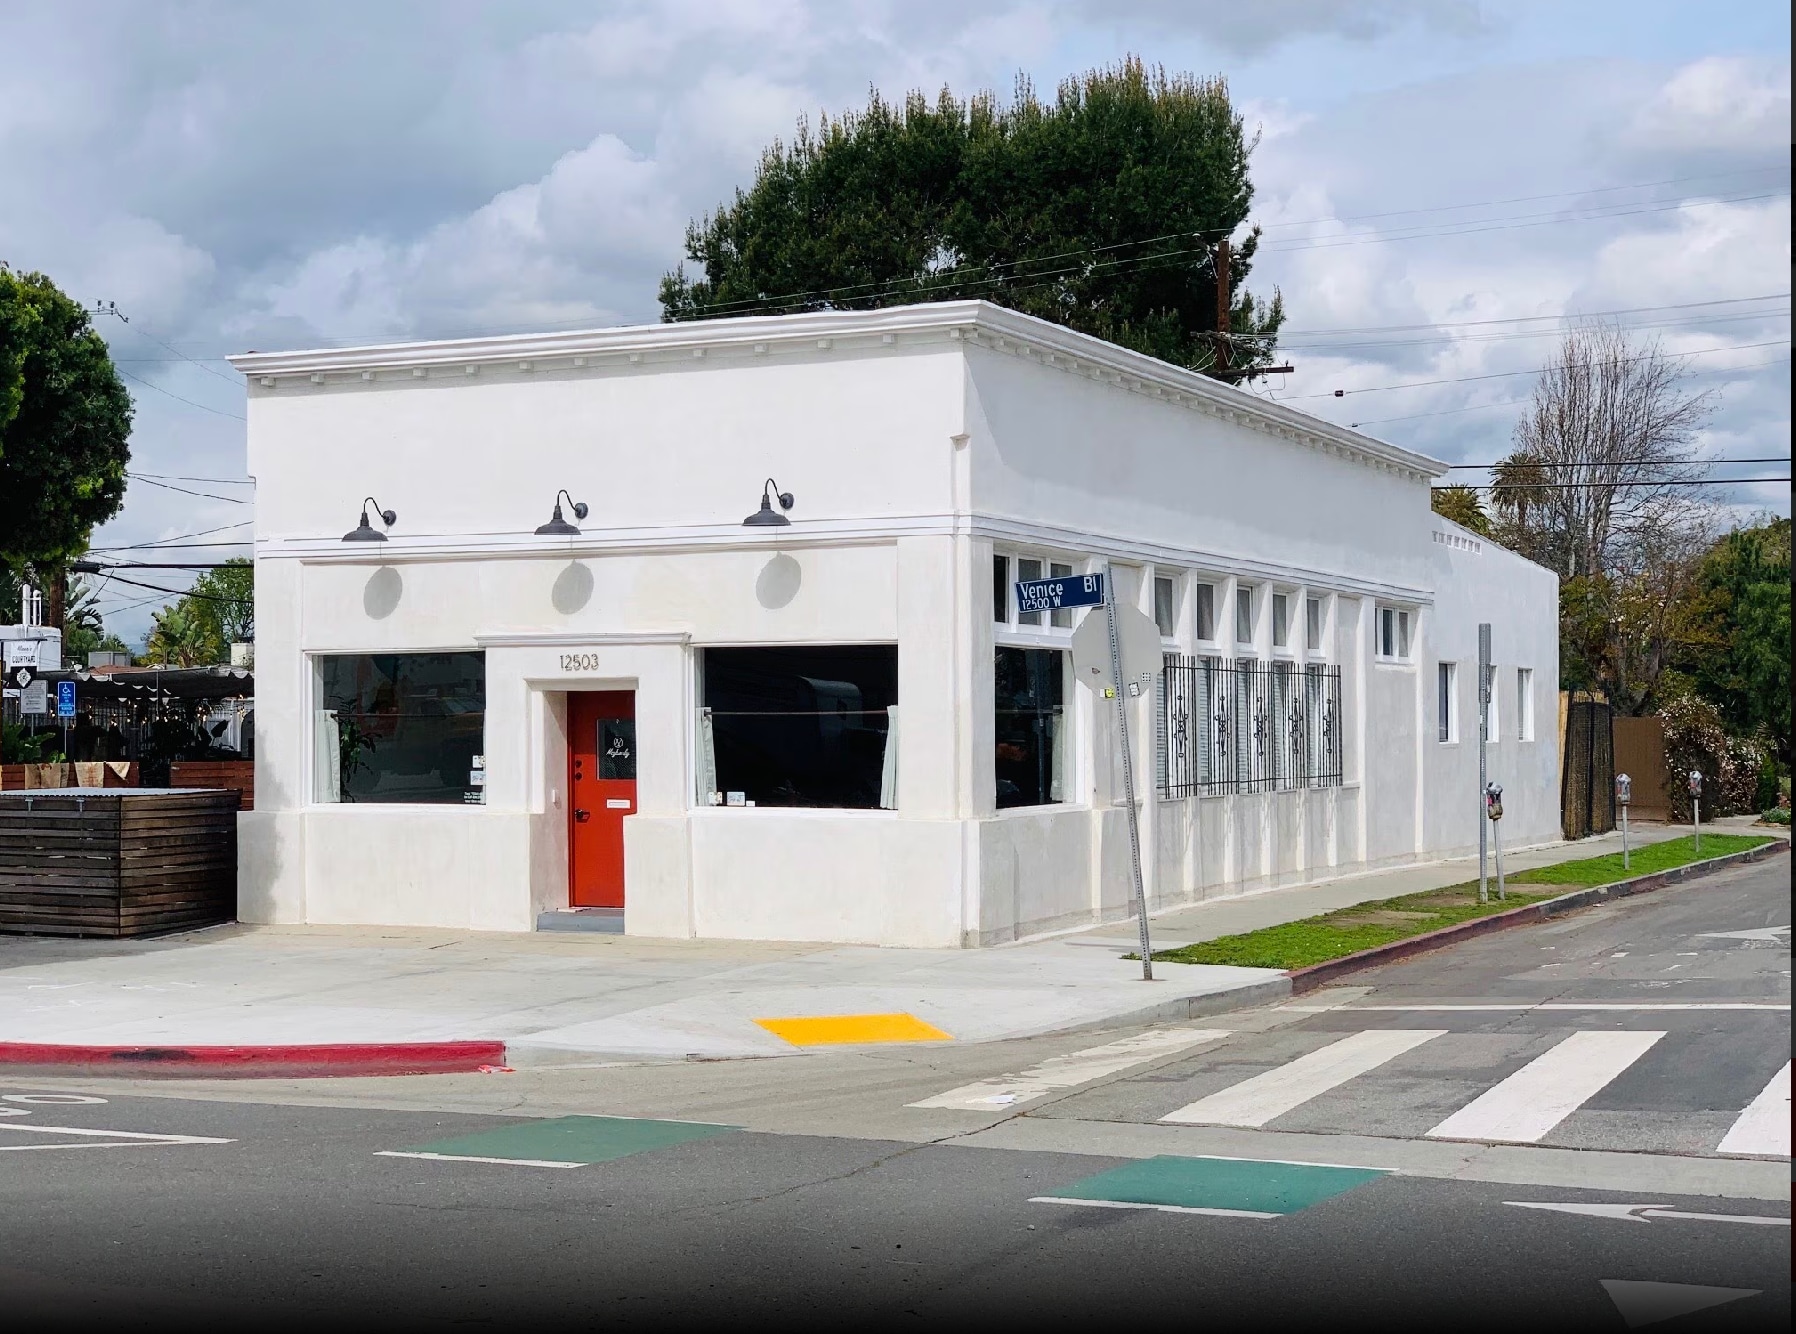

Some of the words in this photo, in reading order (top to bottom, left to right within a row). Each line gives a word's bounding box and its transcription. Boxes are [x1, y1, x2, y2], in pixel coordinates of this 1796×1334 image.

[1020, 583, 1063, 599] Venice
[1083, 576, 1097, 593] Bl
[1022, 598, 1050, 610] 12500
[1052, 596, 1061, 607] W
[560, 653, 599, 671] 12503
